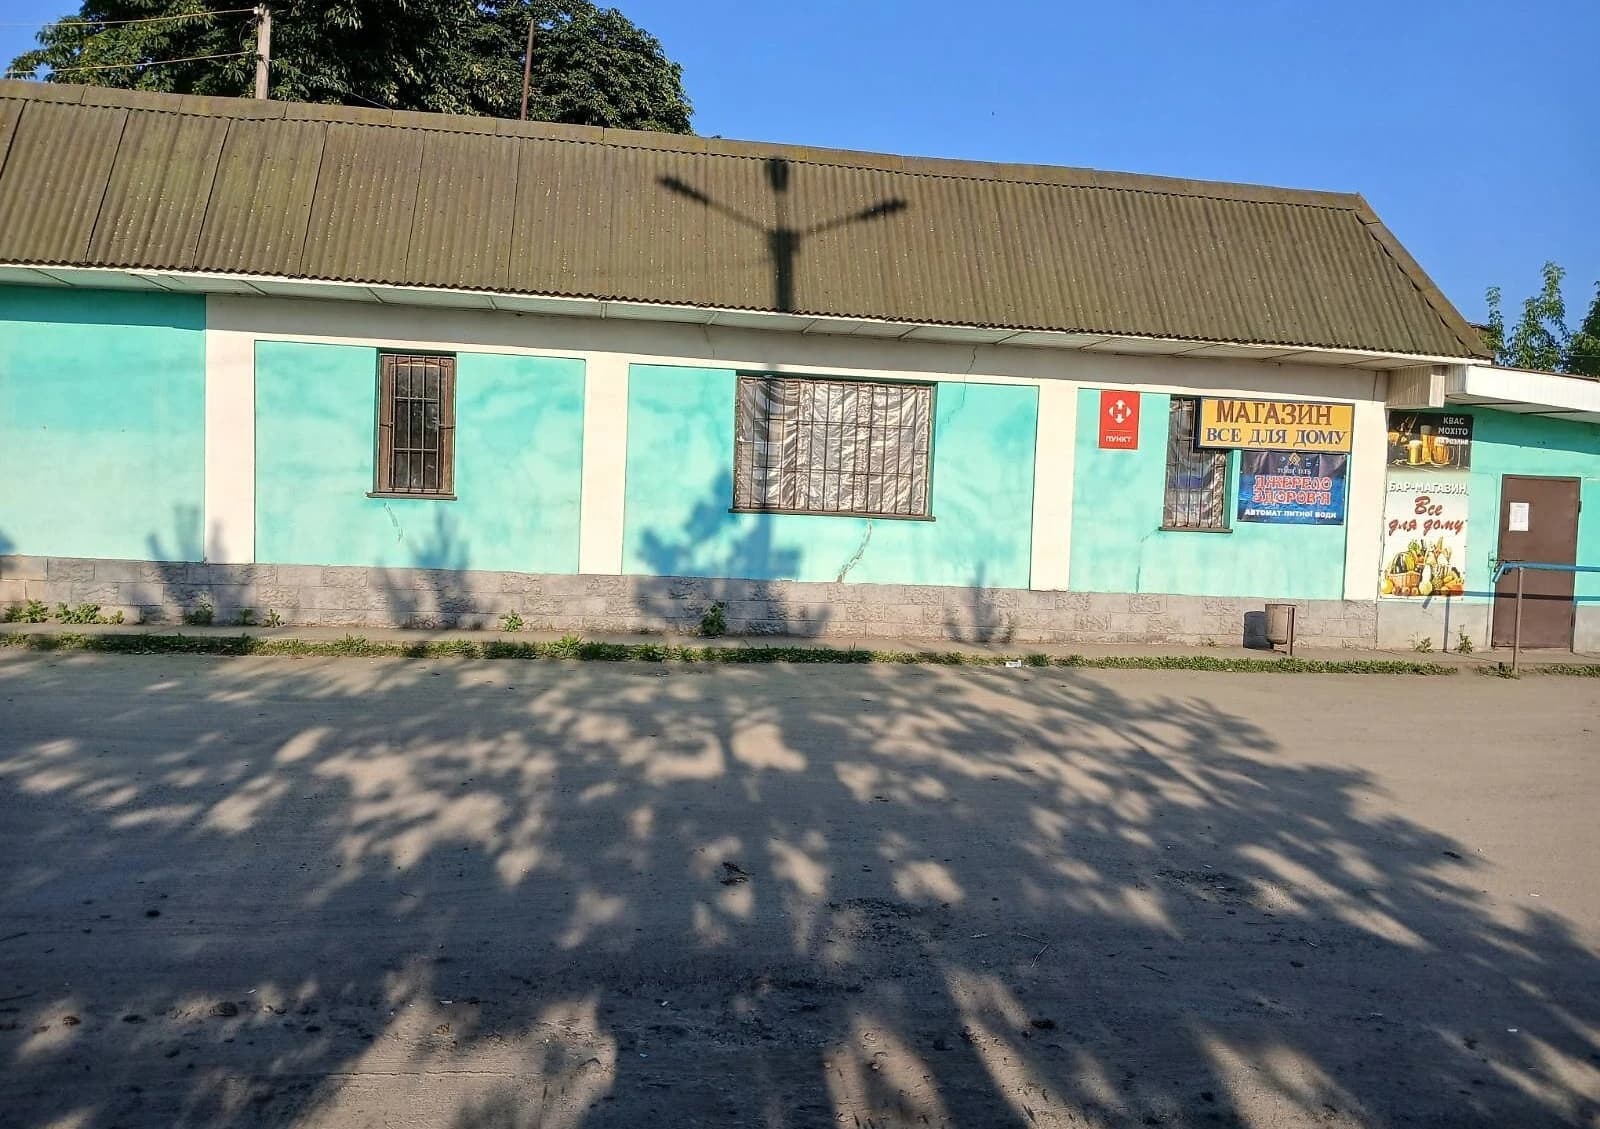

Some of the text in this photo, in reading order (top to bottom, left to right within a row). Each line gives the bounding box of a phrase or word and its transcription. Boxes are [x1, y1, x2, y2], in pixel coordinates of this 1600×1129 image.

[1216, 400, 1332, 425] МАГАЗИН
[1443, 416, 1465, 425] КВАС
[1206, 427, 1348, 447] ВСЕ ДЛЯ ДОМУ
[1254, 475, 1333, 491] ДЖЕРЕЛО
[1245, 509, 1281, 517] АВТОМАТ
[1414, 495, 1443, 516] Все
[1388, 519, 1464, 536] для дому
